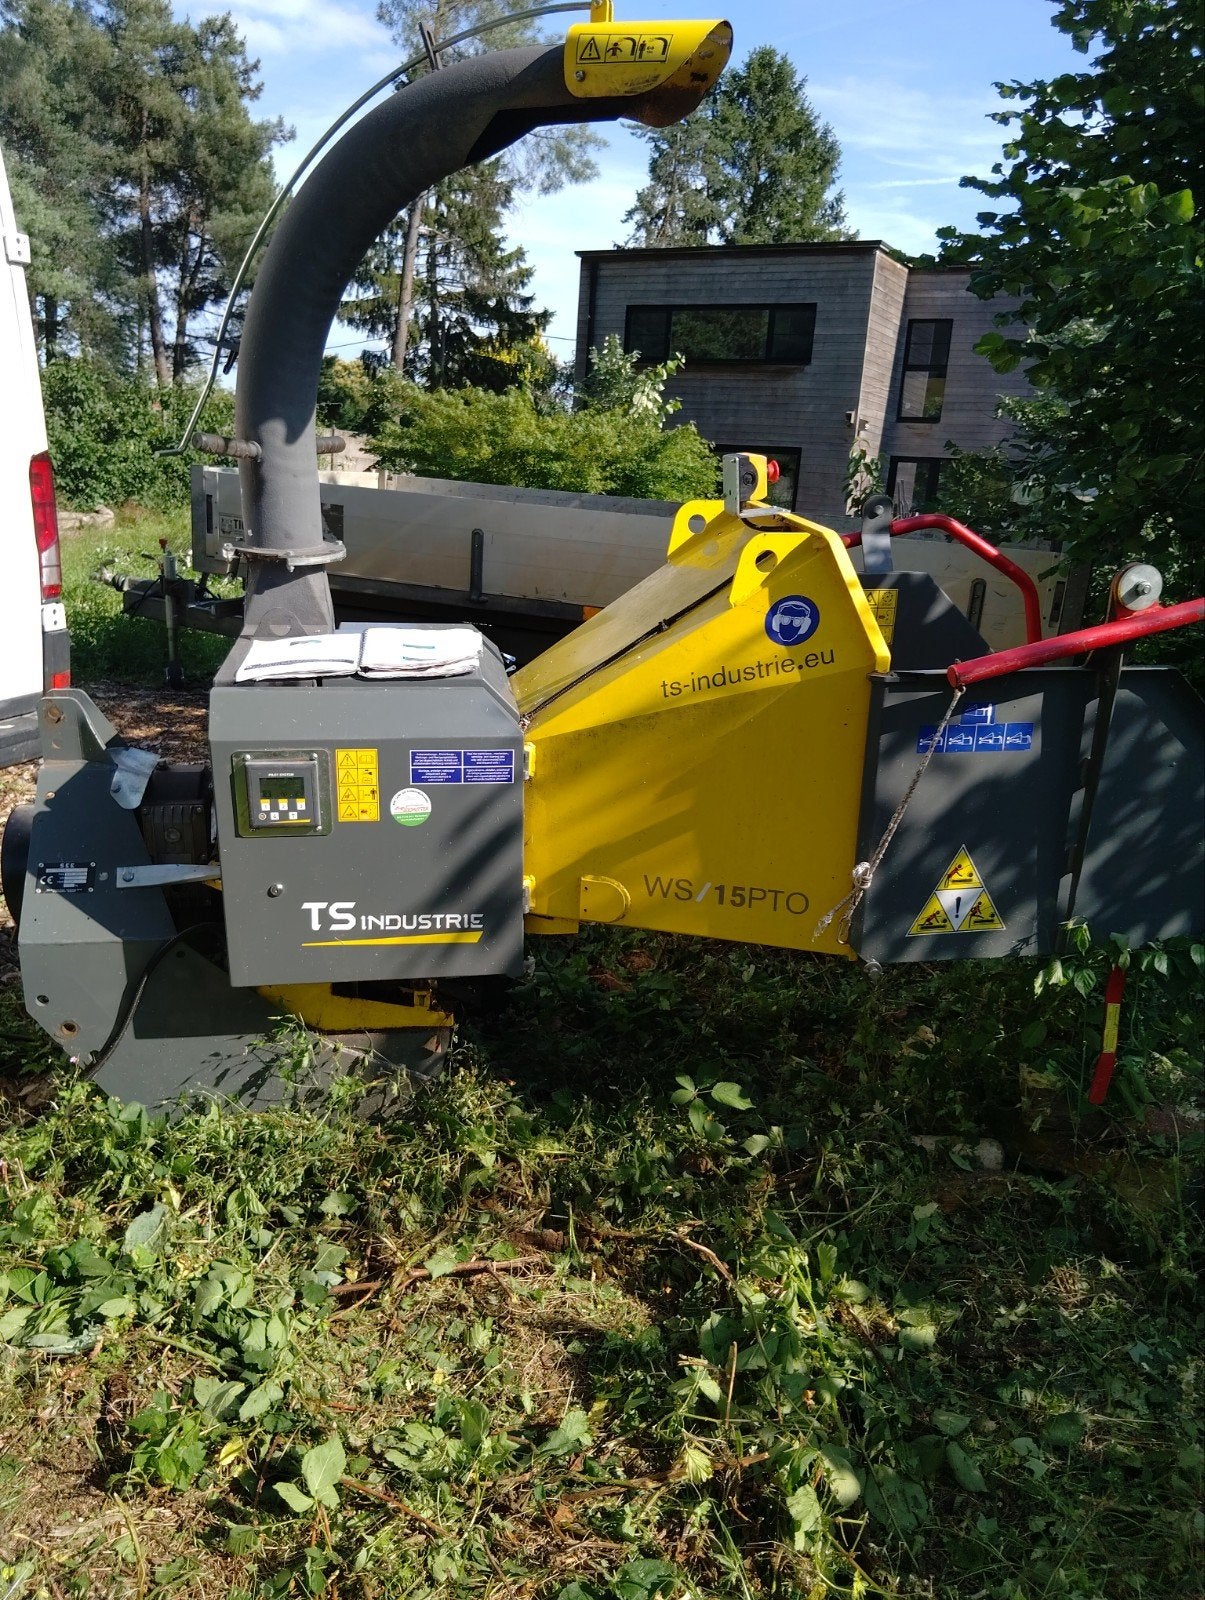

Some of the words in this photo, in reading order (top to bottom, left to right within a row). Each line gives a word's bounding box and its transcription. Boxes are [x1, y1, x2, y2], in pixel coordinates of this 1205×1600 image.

[660, 649, 835, 698] ts-industrie.eu
[302, 902, 357, 931] TS
[361, 914, 484, 931] INDUSTRIE
